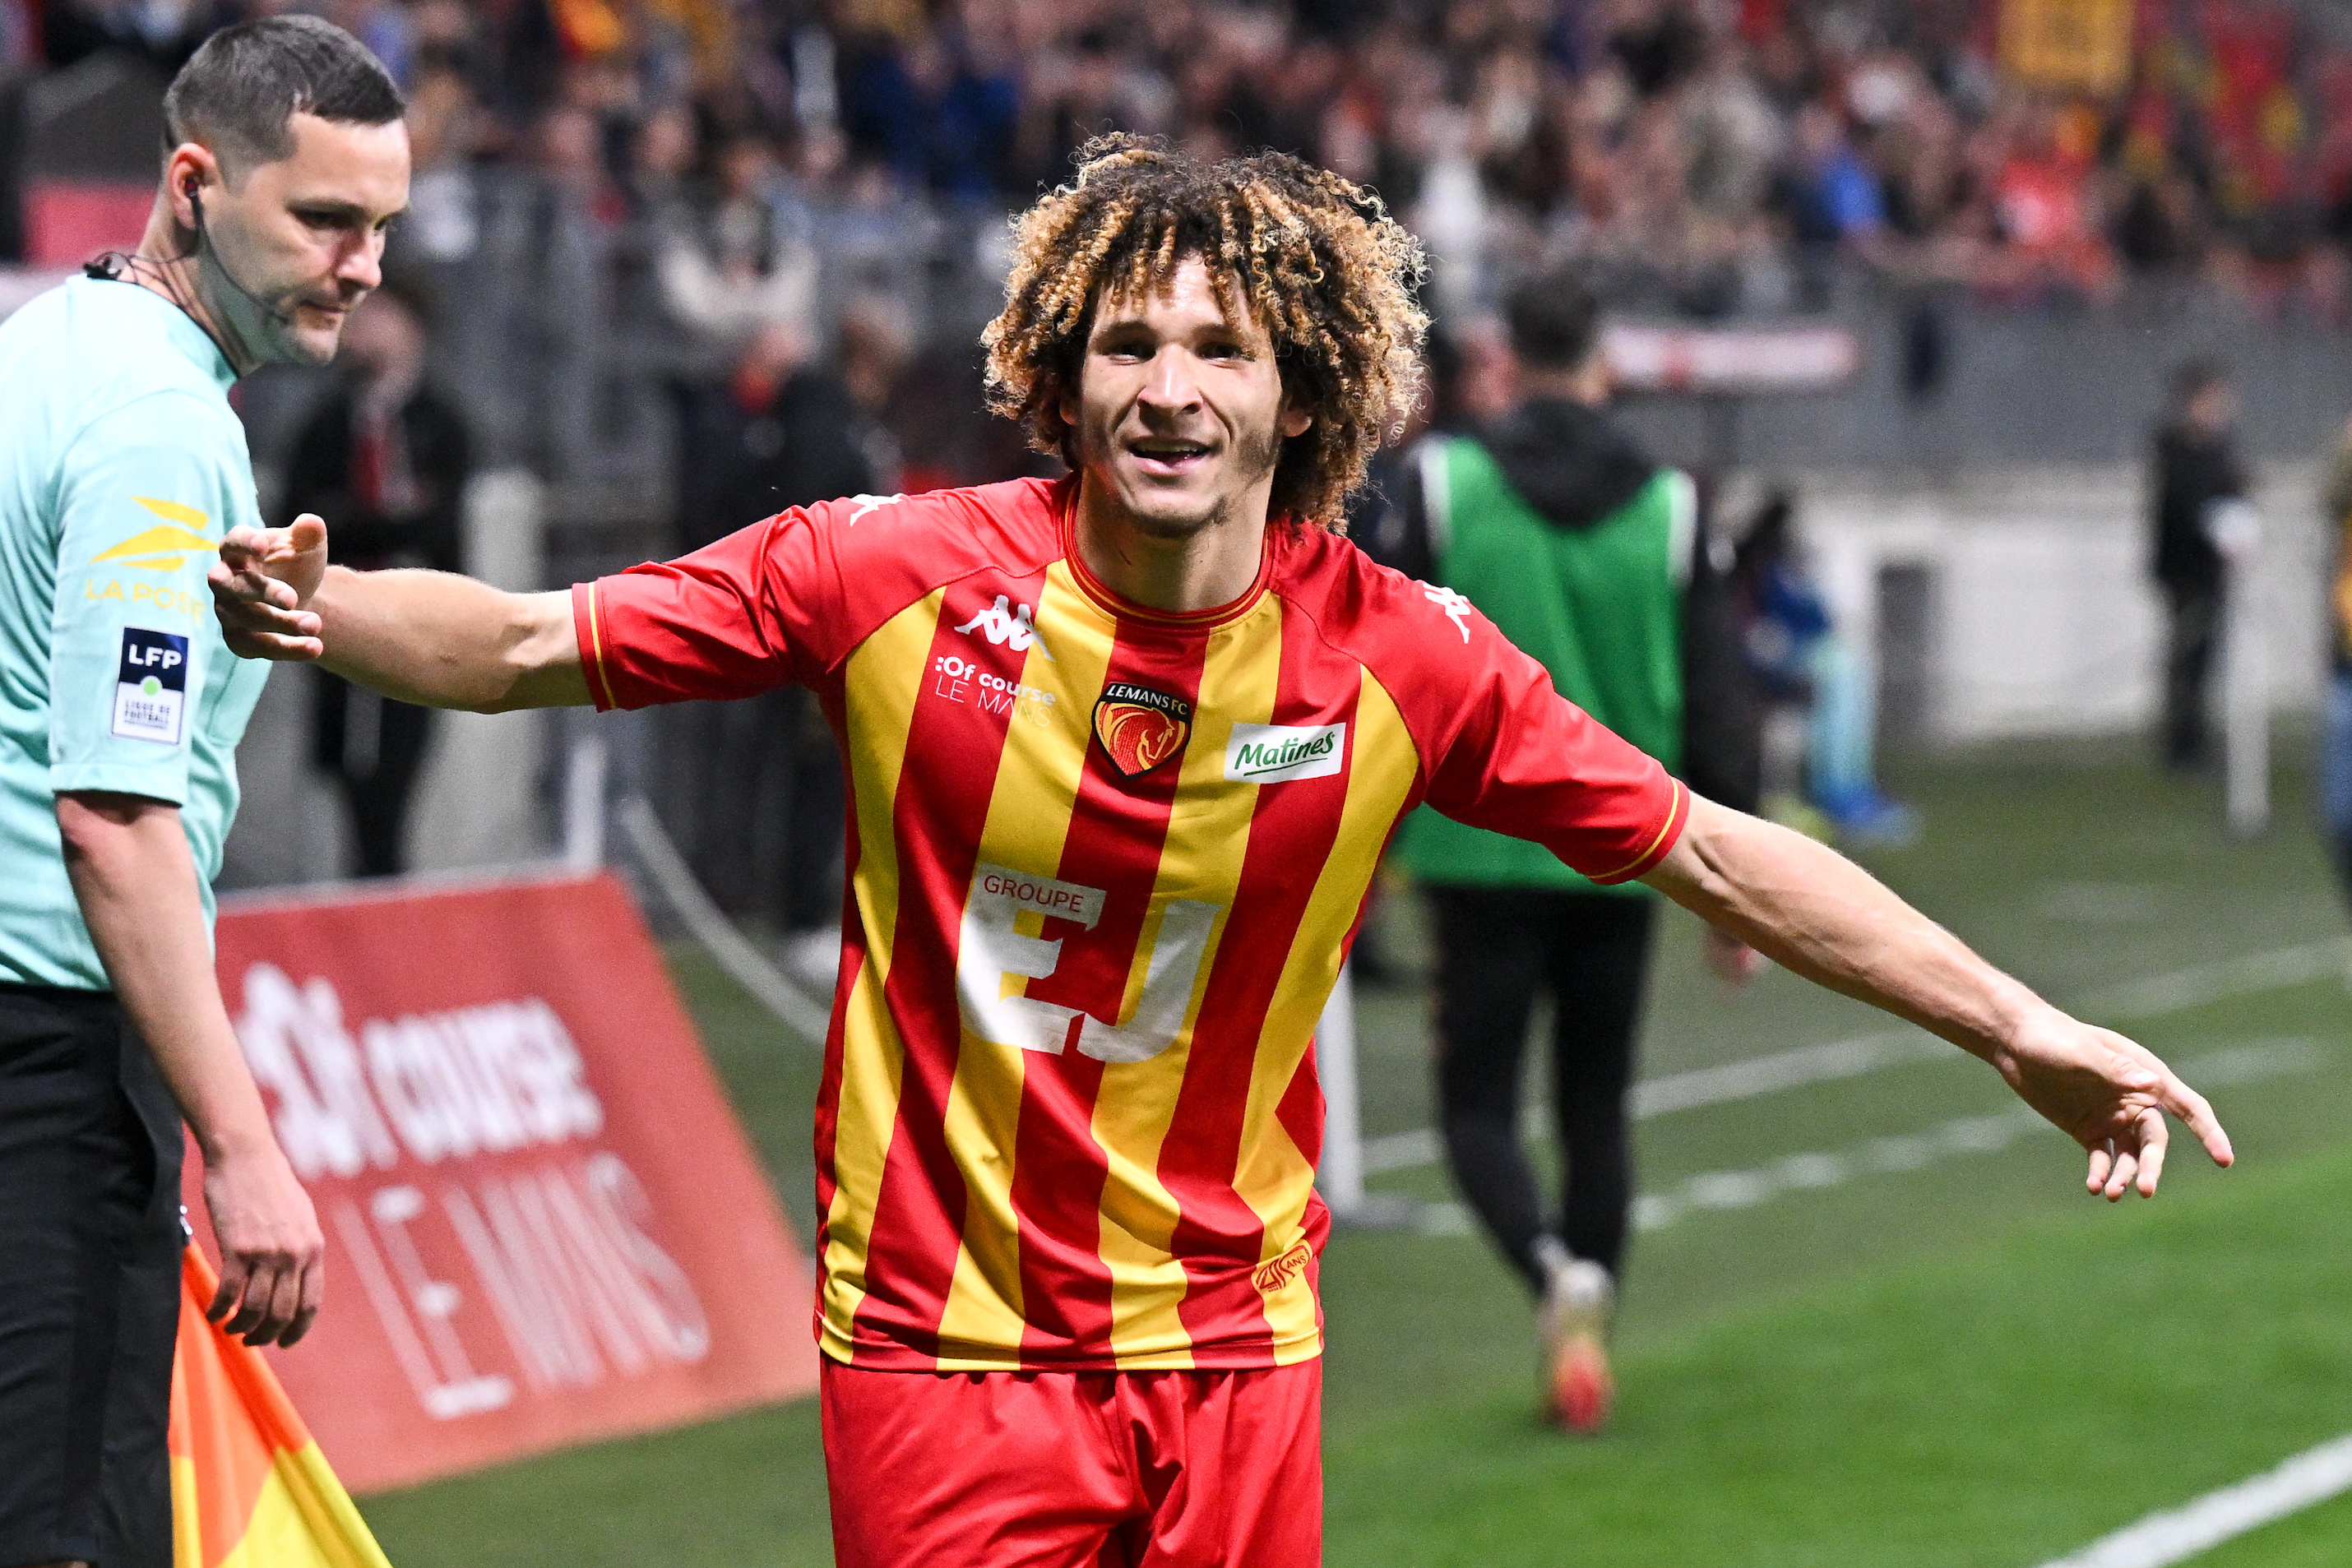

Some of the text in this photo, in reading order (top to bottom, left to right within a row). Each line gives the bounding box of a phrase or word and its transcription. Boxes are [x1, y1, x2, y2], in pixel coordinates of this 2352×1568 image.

[86, 578, 206, 625] LA POSE
[128, 643, 183, 669] LFP
[936, 674, 1053, 727] LE MANS
[979, 673, 1056, 705] course
[1171, 699, 1188, 715] FC
[1234, 731, 1336, 770] Matines
[984, 874, 1084, 913] GROUPE
[956, 861, 1223, 1064] EJ
[1286, 1255, 1307, 1269] ANS
